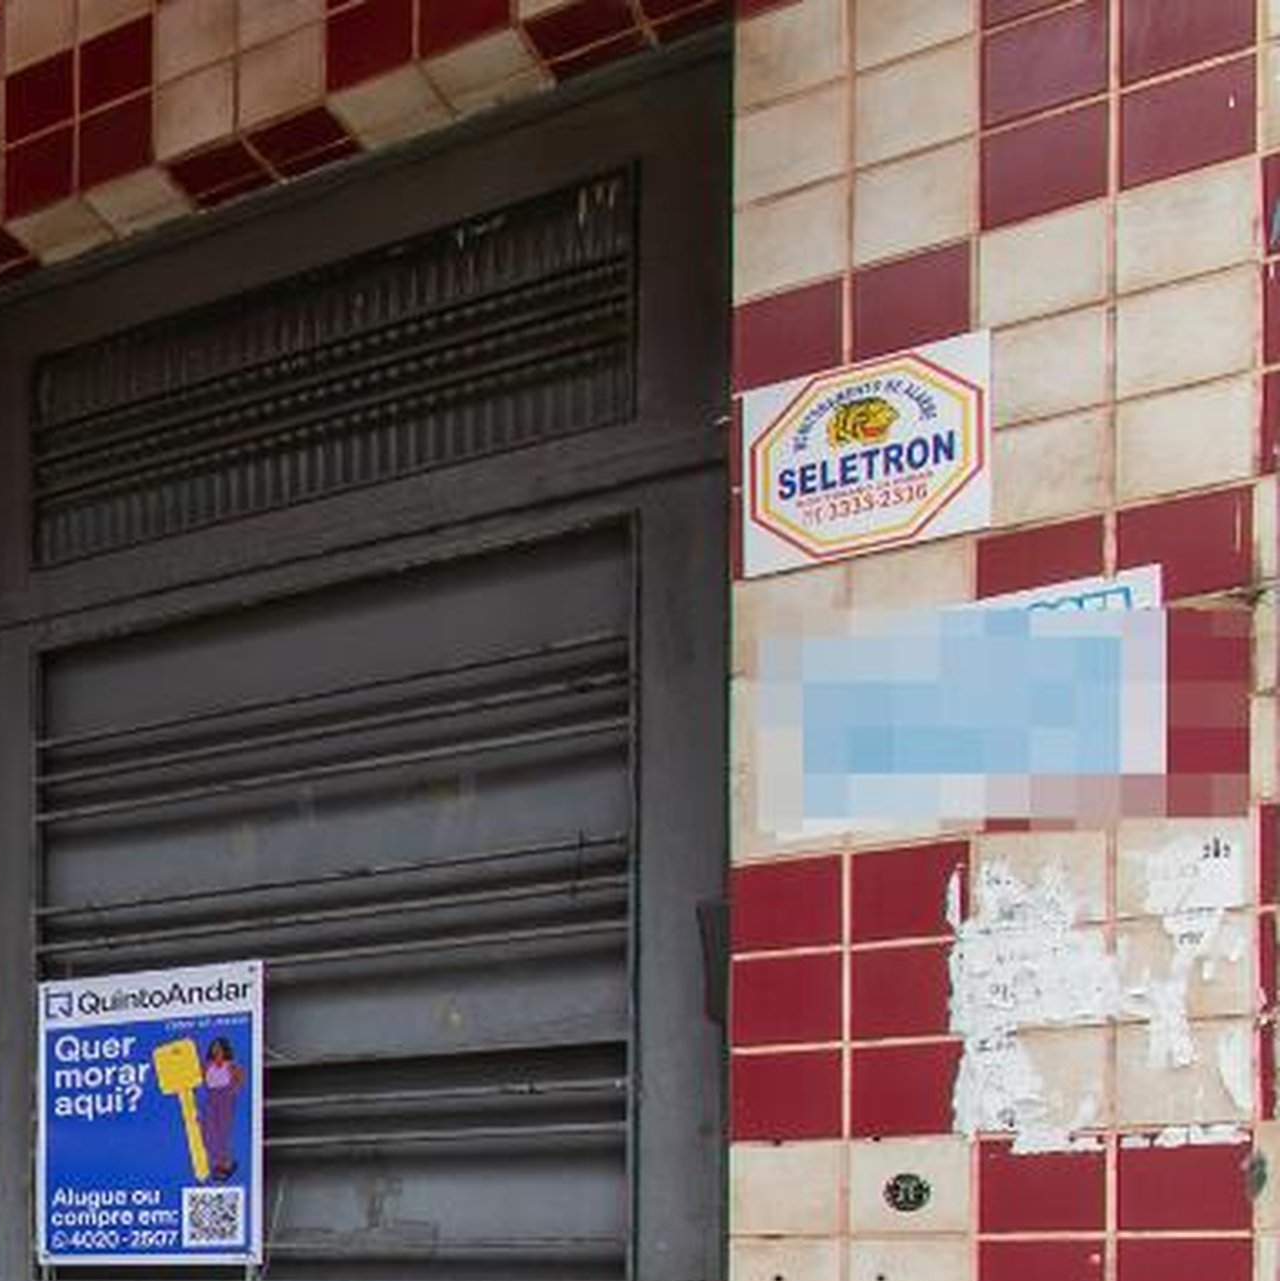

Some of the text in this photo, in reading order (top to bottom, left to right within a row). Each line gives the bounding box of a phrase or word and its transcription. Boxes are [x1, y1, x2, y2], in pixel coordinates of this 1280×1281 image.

[778, 430, 956, 500] SELETRON
[78, 978, 252, 1016] QuintoAndar
[54, 1035, 137, 1062] Quer
[54, 1063, 151, 1089] morar
[54, 1083, 143, 1122] aqui?
[52, 1187, 161, 1211] Alugue ou
[51, 1209, 180, 1229] compre em:
